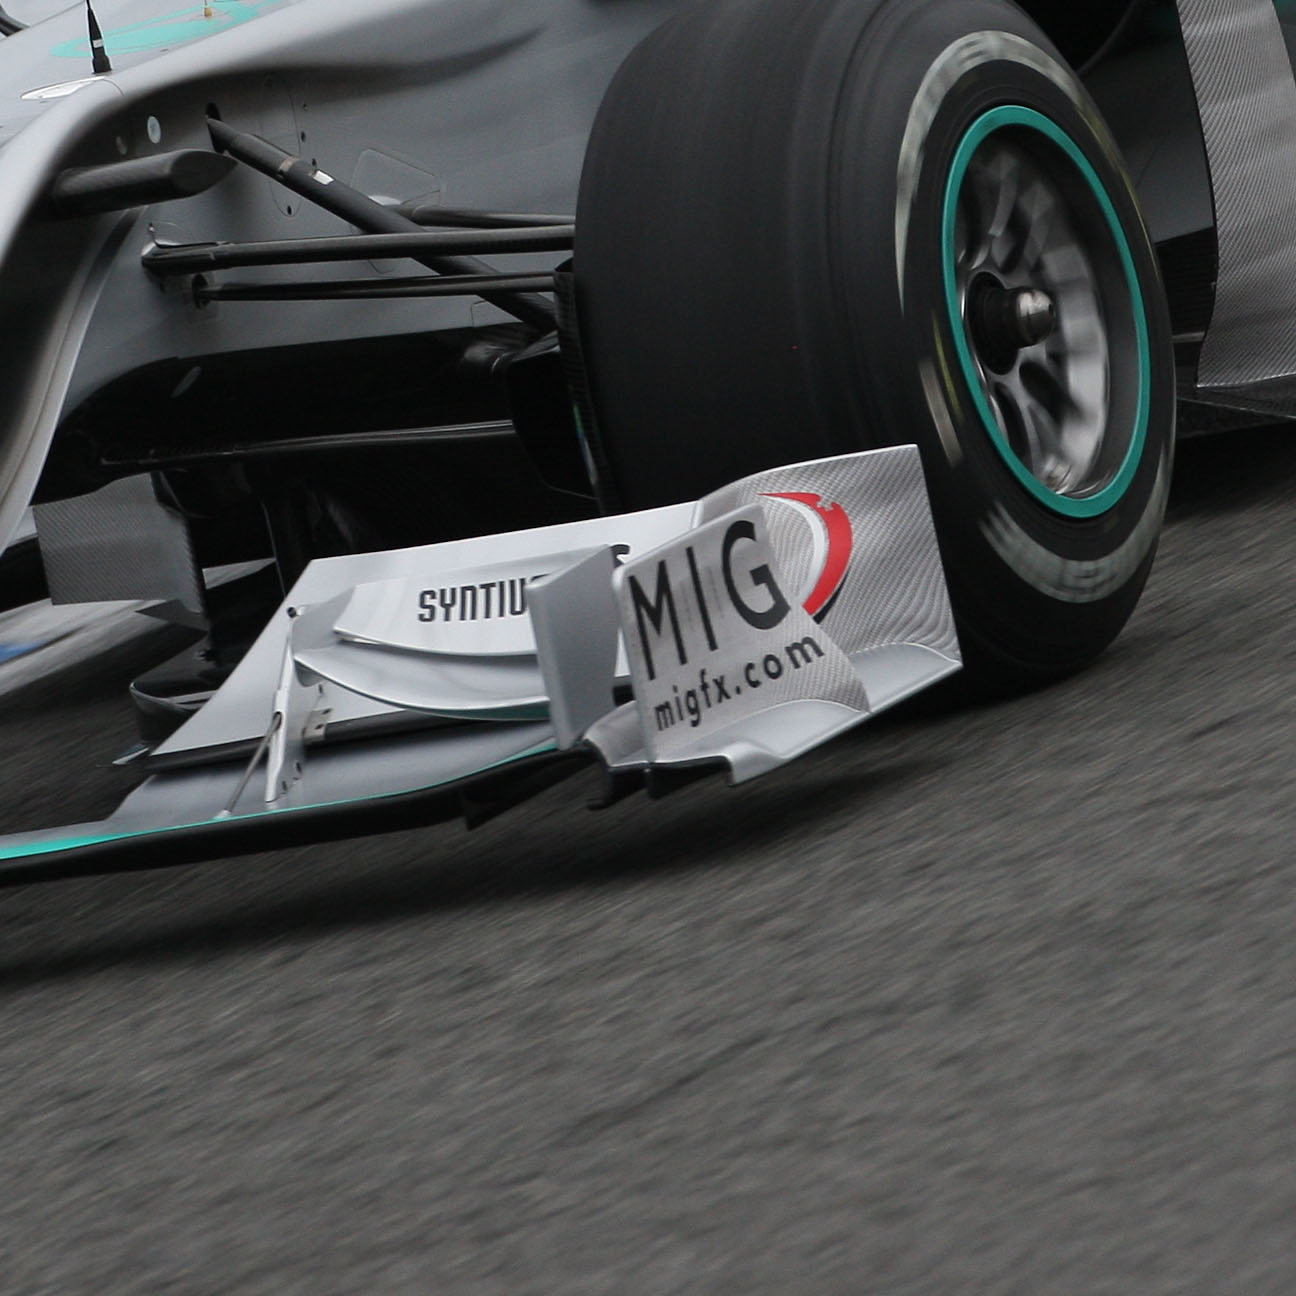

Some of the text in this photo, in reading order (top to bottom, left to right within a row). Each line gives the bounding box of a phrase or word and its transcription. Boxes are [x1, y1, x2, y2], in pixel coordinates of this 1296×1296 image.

[417, 572, 551, 623] SYNTIU
[627, 519, 792, 682] MIG
[653, 635, 826, 732] migfx.com
